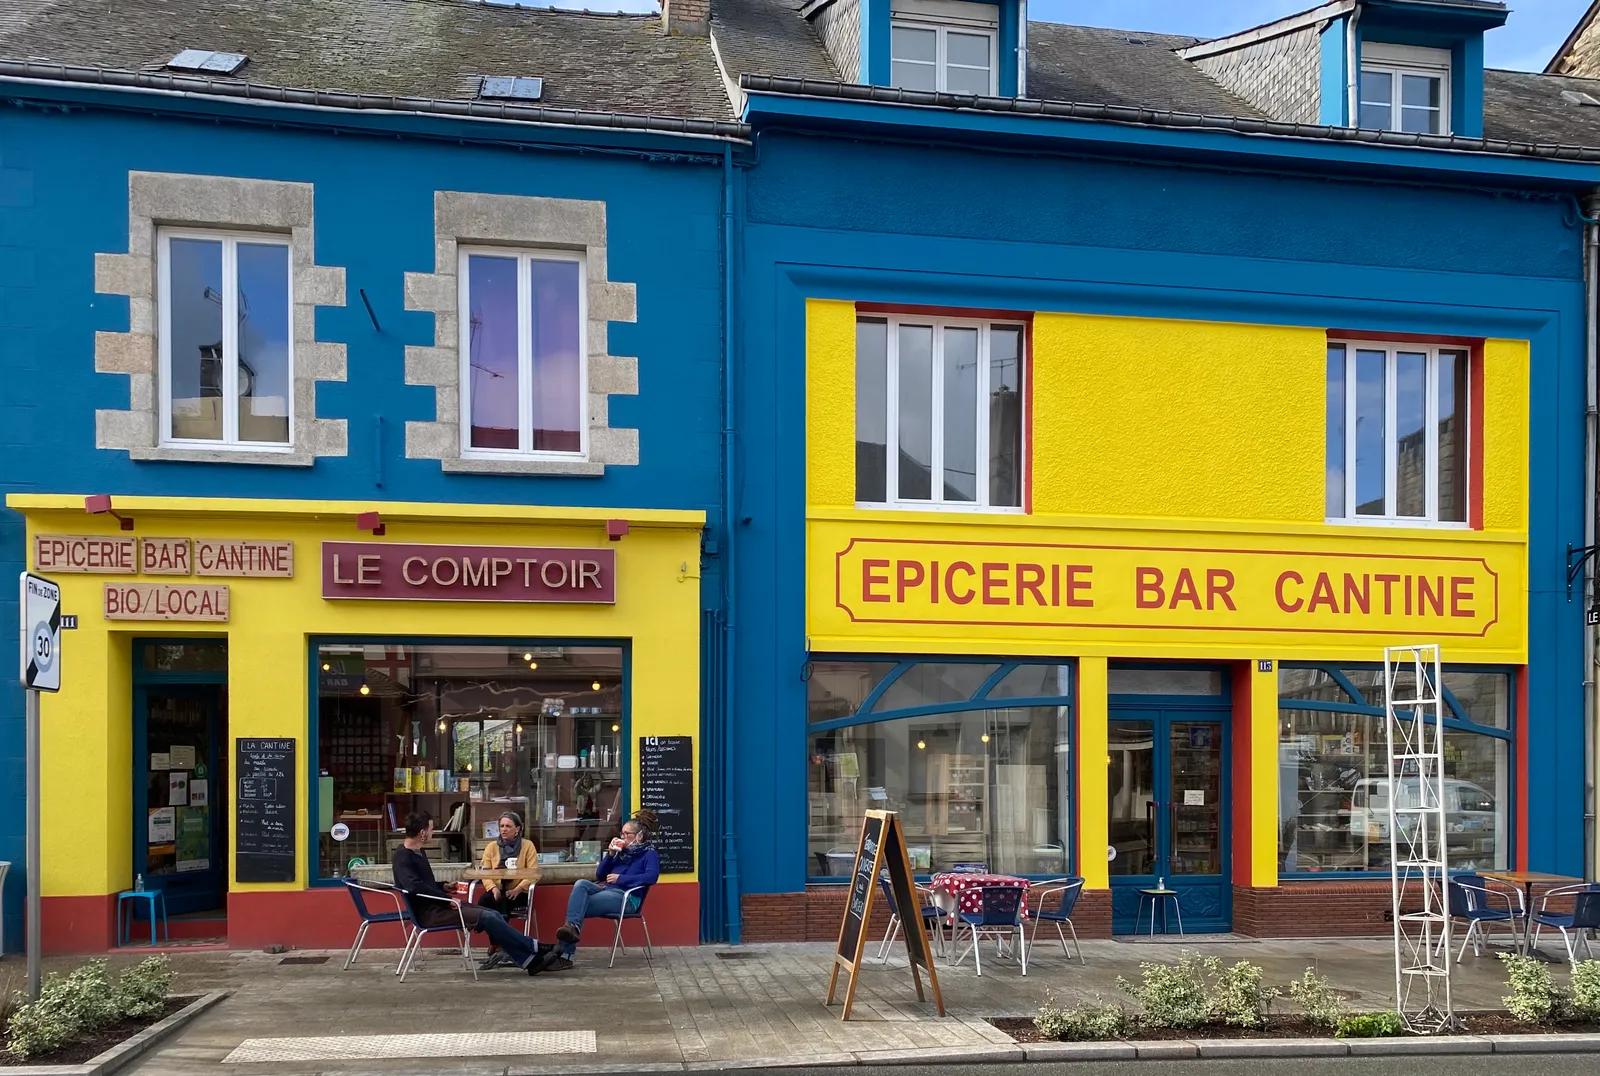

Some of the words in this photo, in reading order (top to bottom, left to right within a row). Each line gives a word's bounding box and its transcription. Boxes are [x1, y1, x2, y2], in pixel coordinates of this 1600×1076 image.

[144, 543, 187, 570] BAR
[333, 553, 382, 585] LE
[402, 555, 603, 589] COMPTOIR
[29, 582, 38, 595] FIN
[43, 587, 57, 601] ZONE
[862, 559, 1094, 608] EPICERIE
[1135, 566, 1237, 611] BAR
[1274, 570, 1475, 617] CANTINE
[61, 617, 75, 628] 111
[1588, 611, 1598, 624] LE
[37, 635, 50, 658] 30
[1259, 661, 1272, 670] 113
[247, 742, 256, 750] LA
[260, 741, 291, 750] CANTINE
[645, 736, 659, 746] ICI
